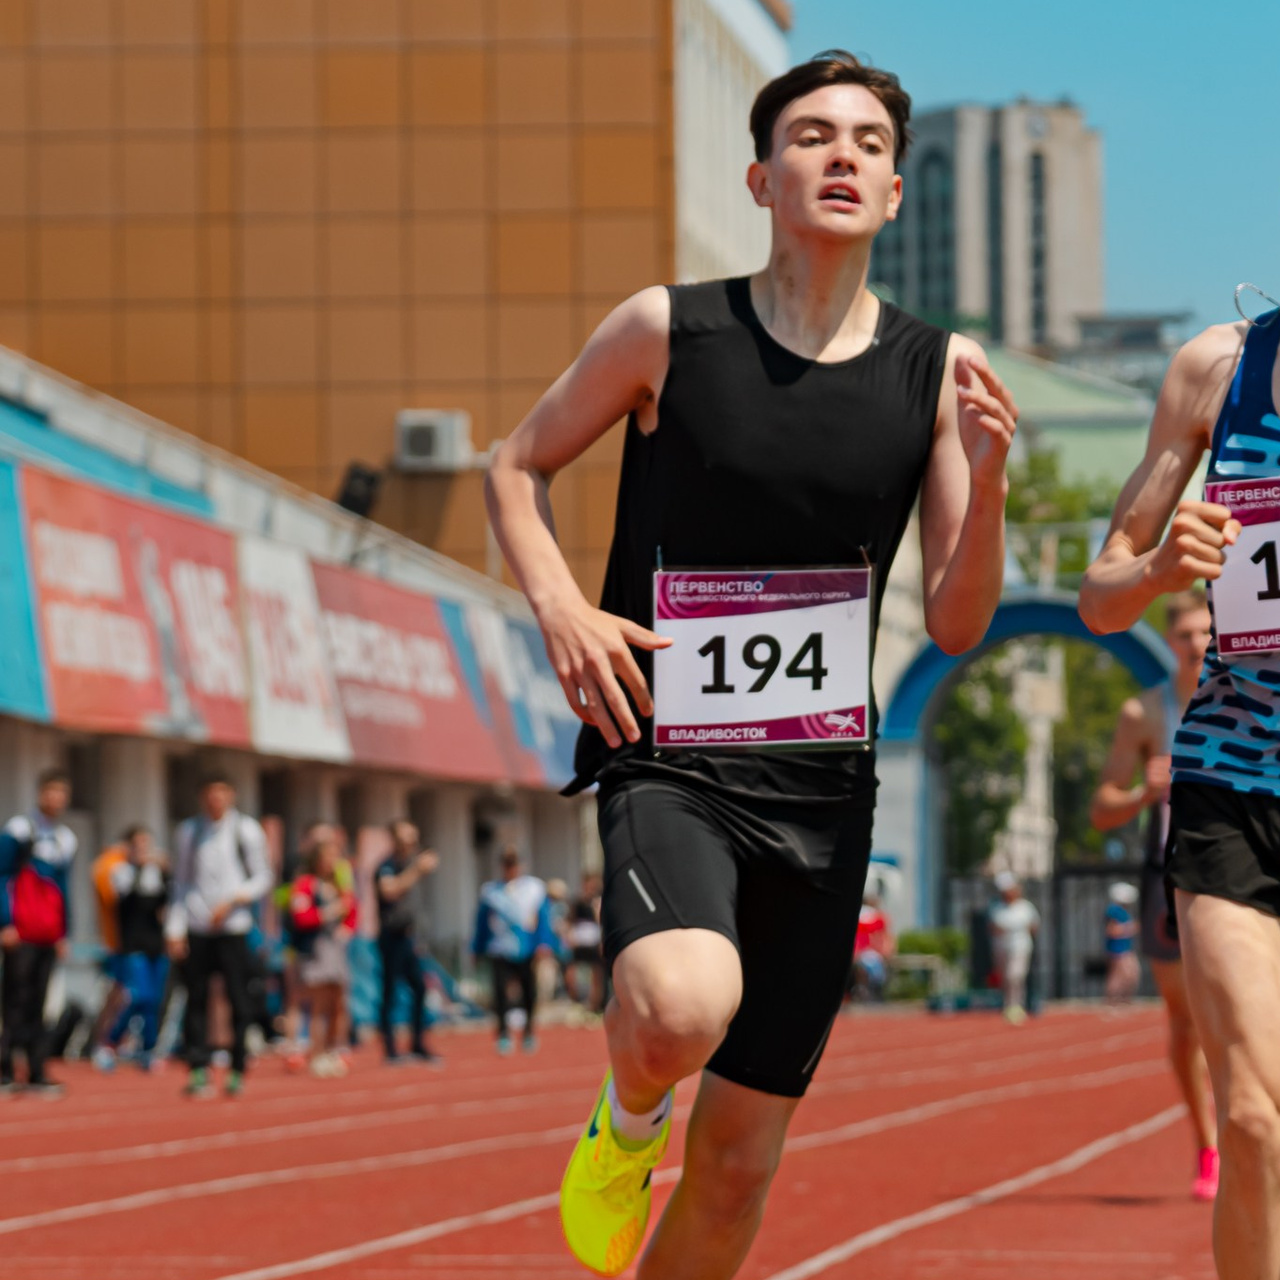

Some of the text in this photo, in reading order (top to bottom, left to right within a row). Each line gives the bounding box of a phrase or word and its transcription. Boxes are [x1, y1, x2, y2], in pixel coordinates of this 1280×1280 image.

[668, 580, 764, 594] ПЕРВЕНСТВО
[698, 631, 829, 695] 194
[667, 726, 768, 742] ВЛАДИВОСТОК
